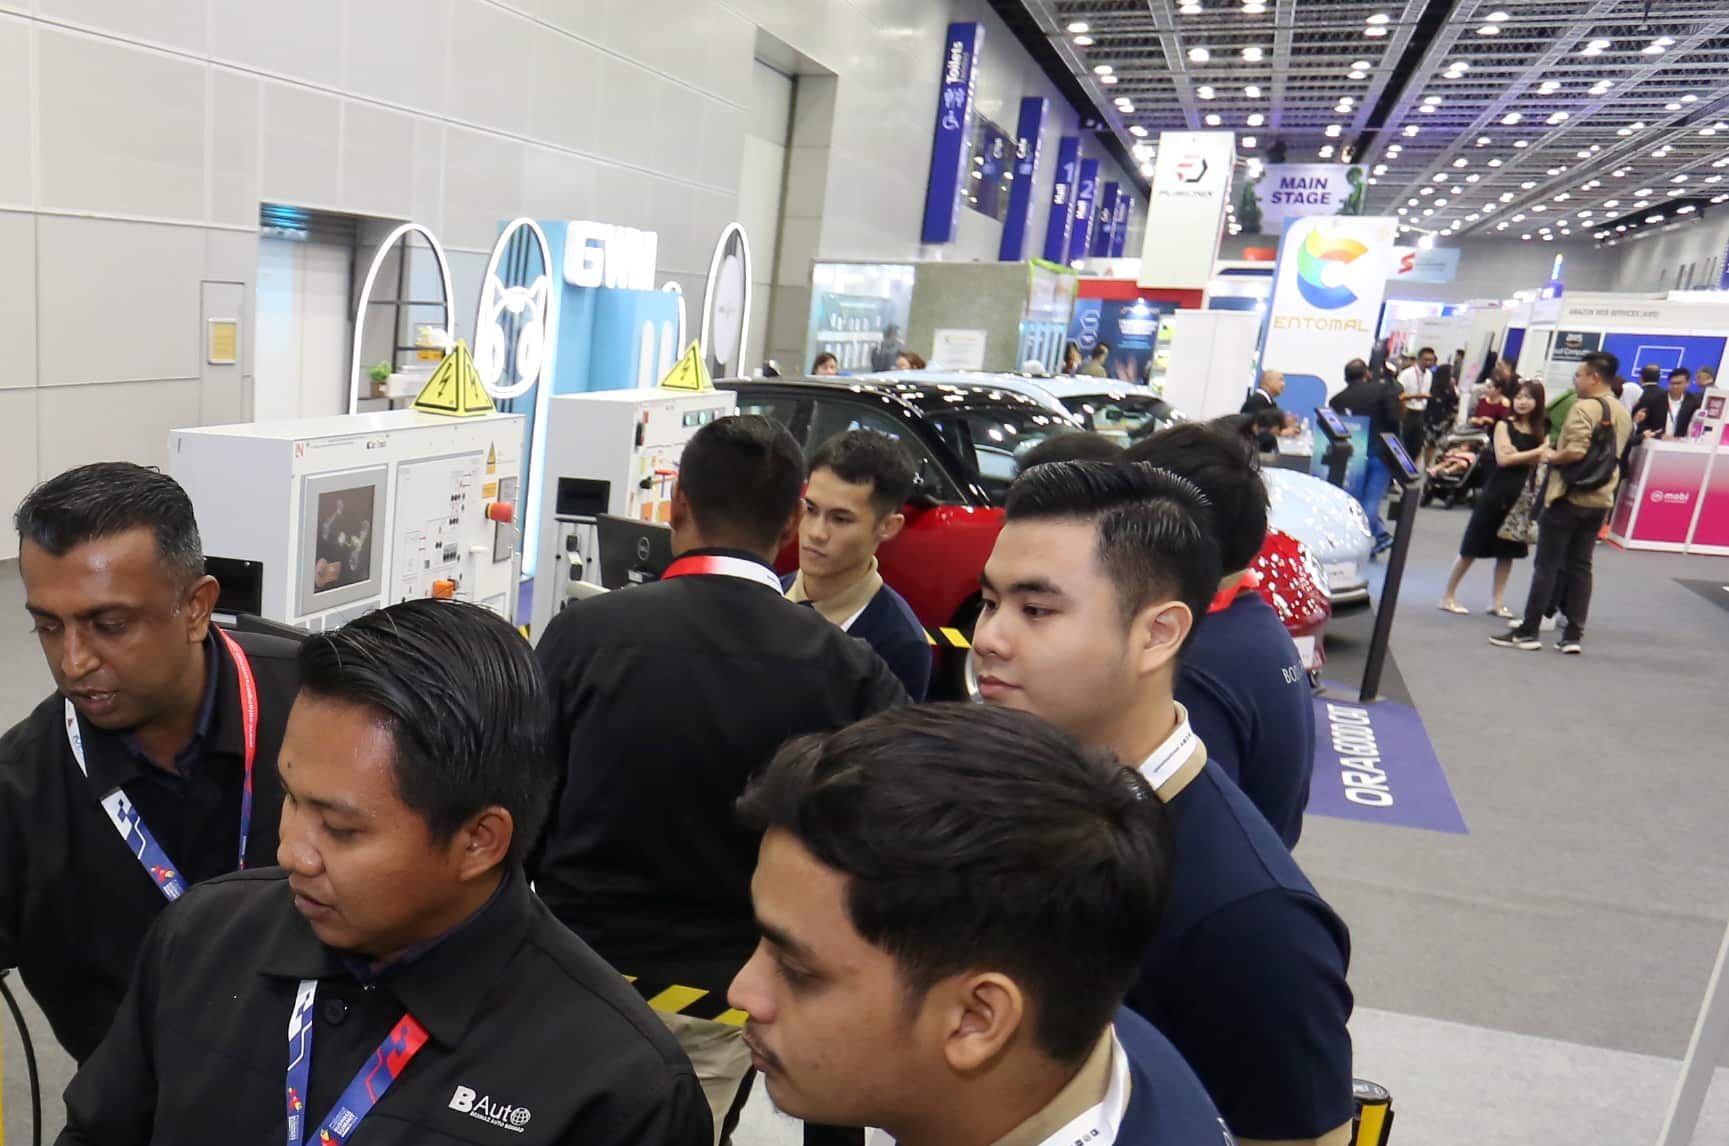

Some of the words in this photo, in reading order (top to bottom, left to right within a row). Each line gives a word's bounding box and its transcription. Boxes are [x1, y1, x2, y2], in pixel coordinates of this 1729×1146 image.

[945, 40, 963, 84] Toilets
[1080, 180, 1094, 199] 2
[1279, 177, 1328, 190] MAIN
[1271, 191, 1332, 205] STAGE
[1272, 316, 1371, 334] ENTOMAL
[1339, 757, 1393, 807] ORA
